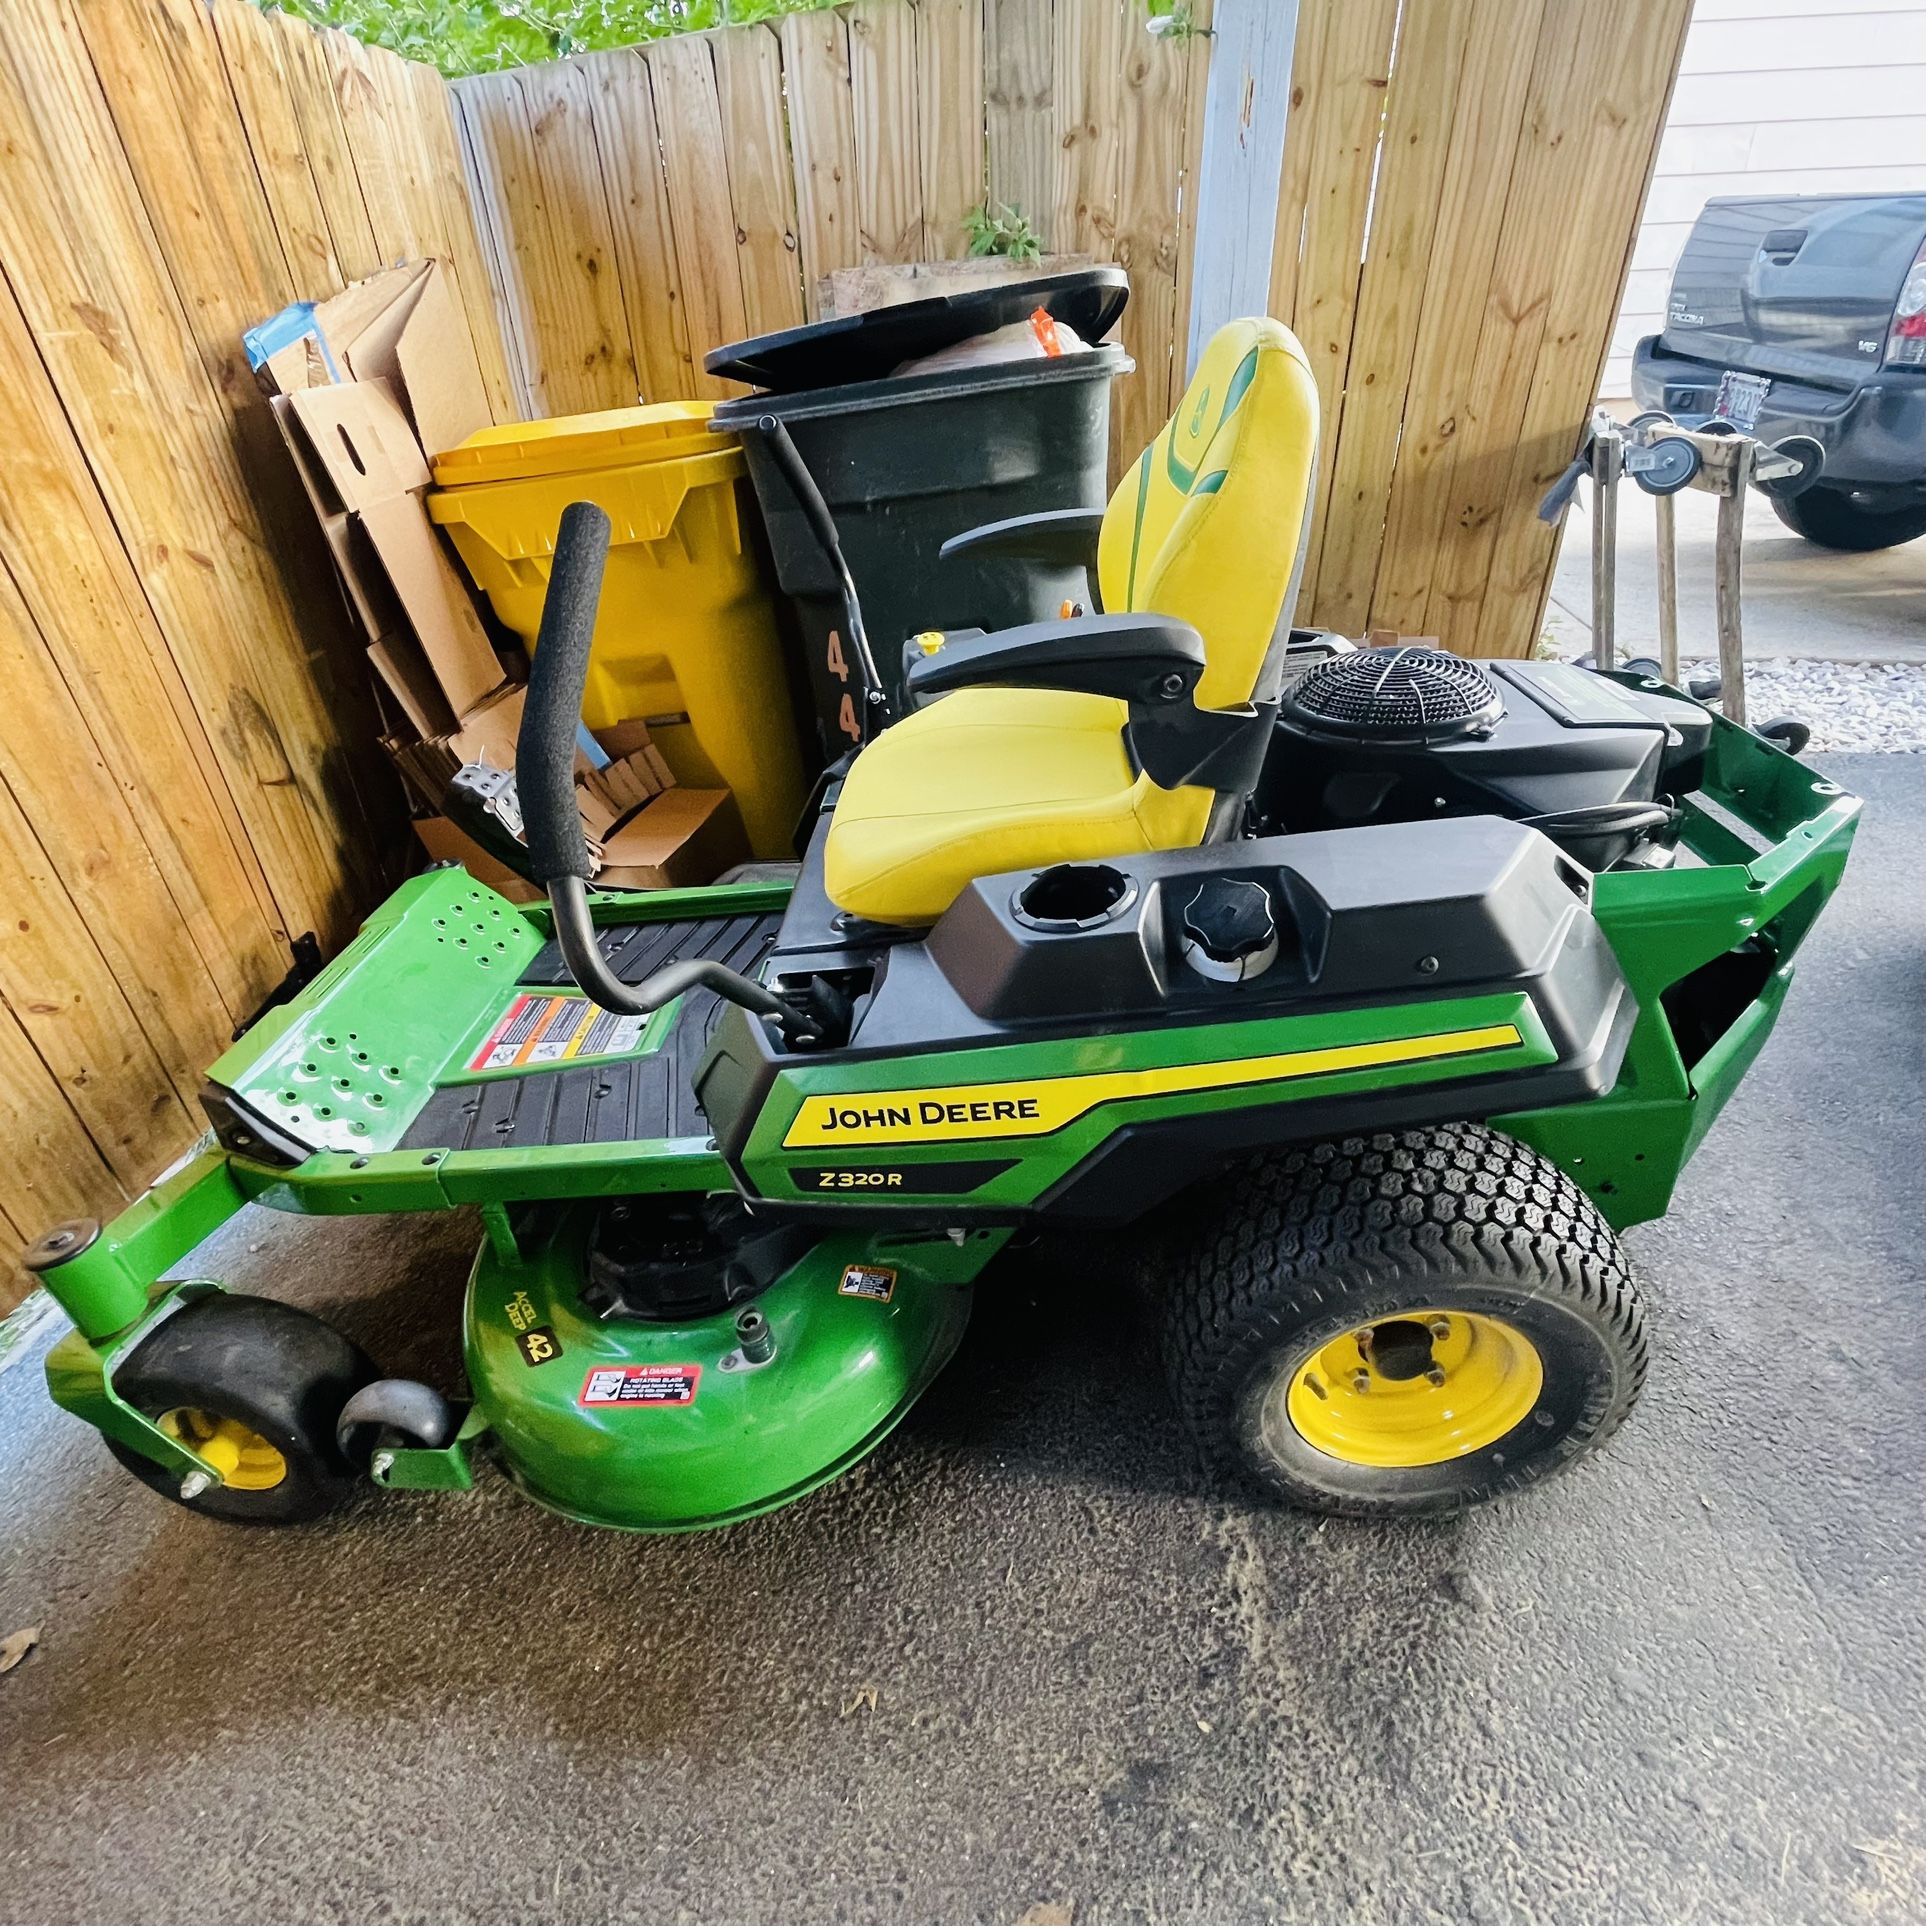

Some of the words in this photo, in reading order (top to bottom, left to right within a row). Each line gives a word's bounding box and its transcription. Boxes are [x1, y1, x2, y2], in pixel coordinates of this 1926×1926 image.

[1858, 340, 1878, 353] V6
[821, 1107, 912, 1130] JOHN
[919, 1099, 1040, 1125] DEERE
[819, 1172, 903, 1187] Z320R
[504, 1302, 527, 1331] DEEP
[513, 1291, 537, 1324] ACCEL
[526, 1333, 553, 1362] 42
[648, 1367, 683, 1376] DANGER
